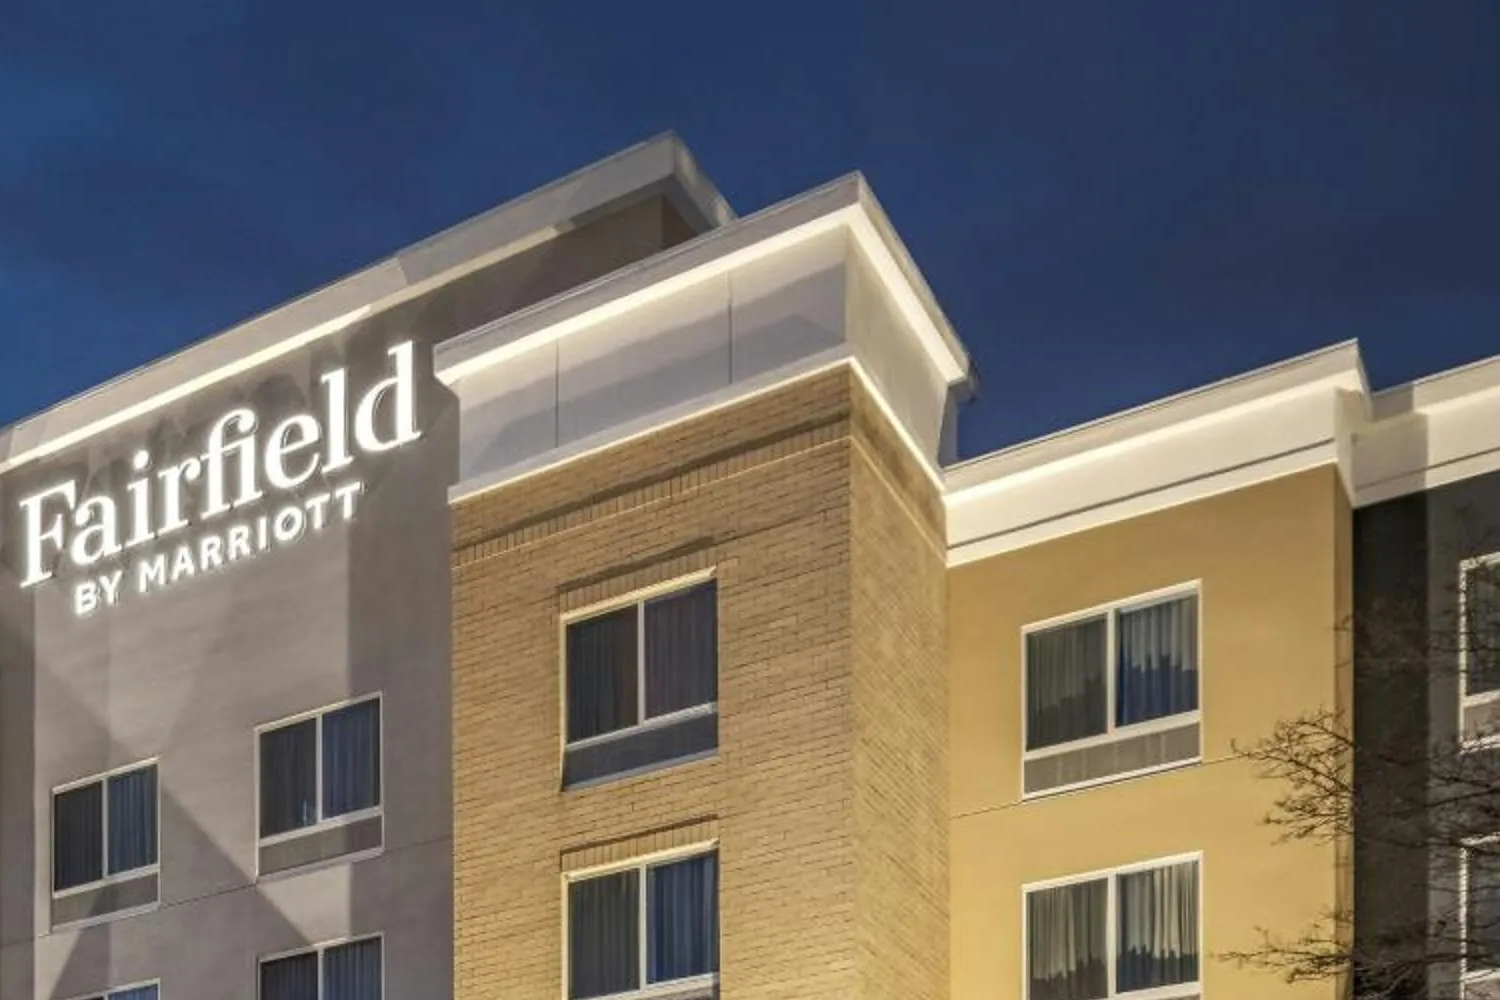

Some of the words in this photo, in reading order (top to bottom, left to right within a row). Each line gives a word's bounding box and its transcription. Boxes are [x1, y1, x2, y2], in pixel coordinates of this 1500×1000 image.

[19, 340, 421, 588] Fairfield
[74, 570, 123, 616] BY
[138, 481, 362, 593] MARRIOTT
